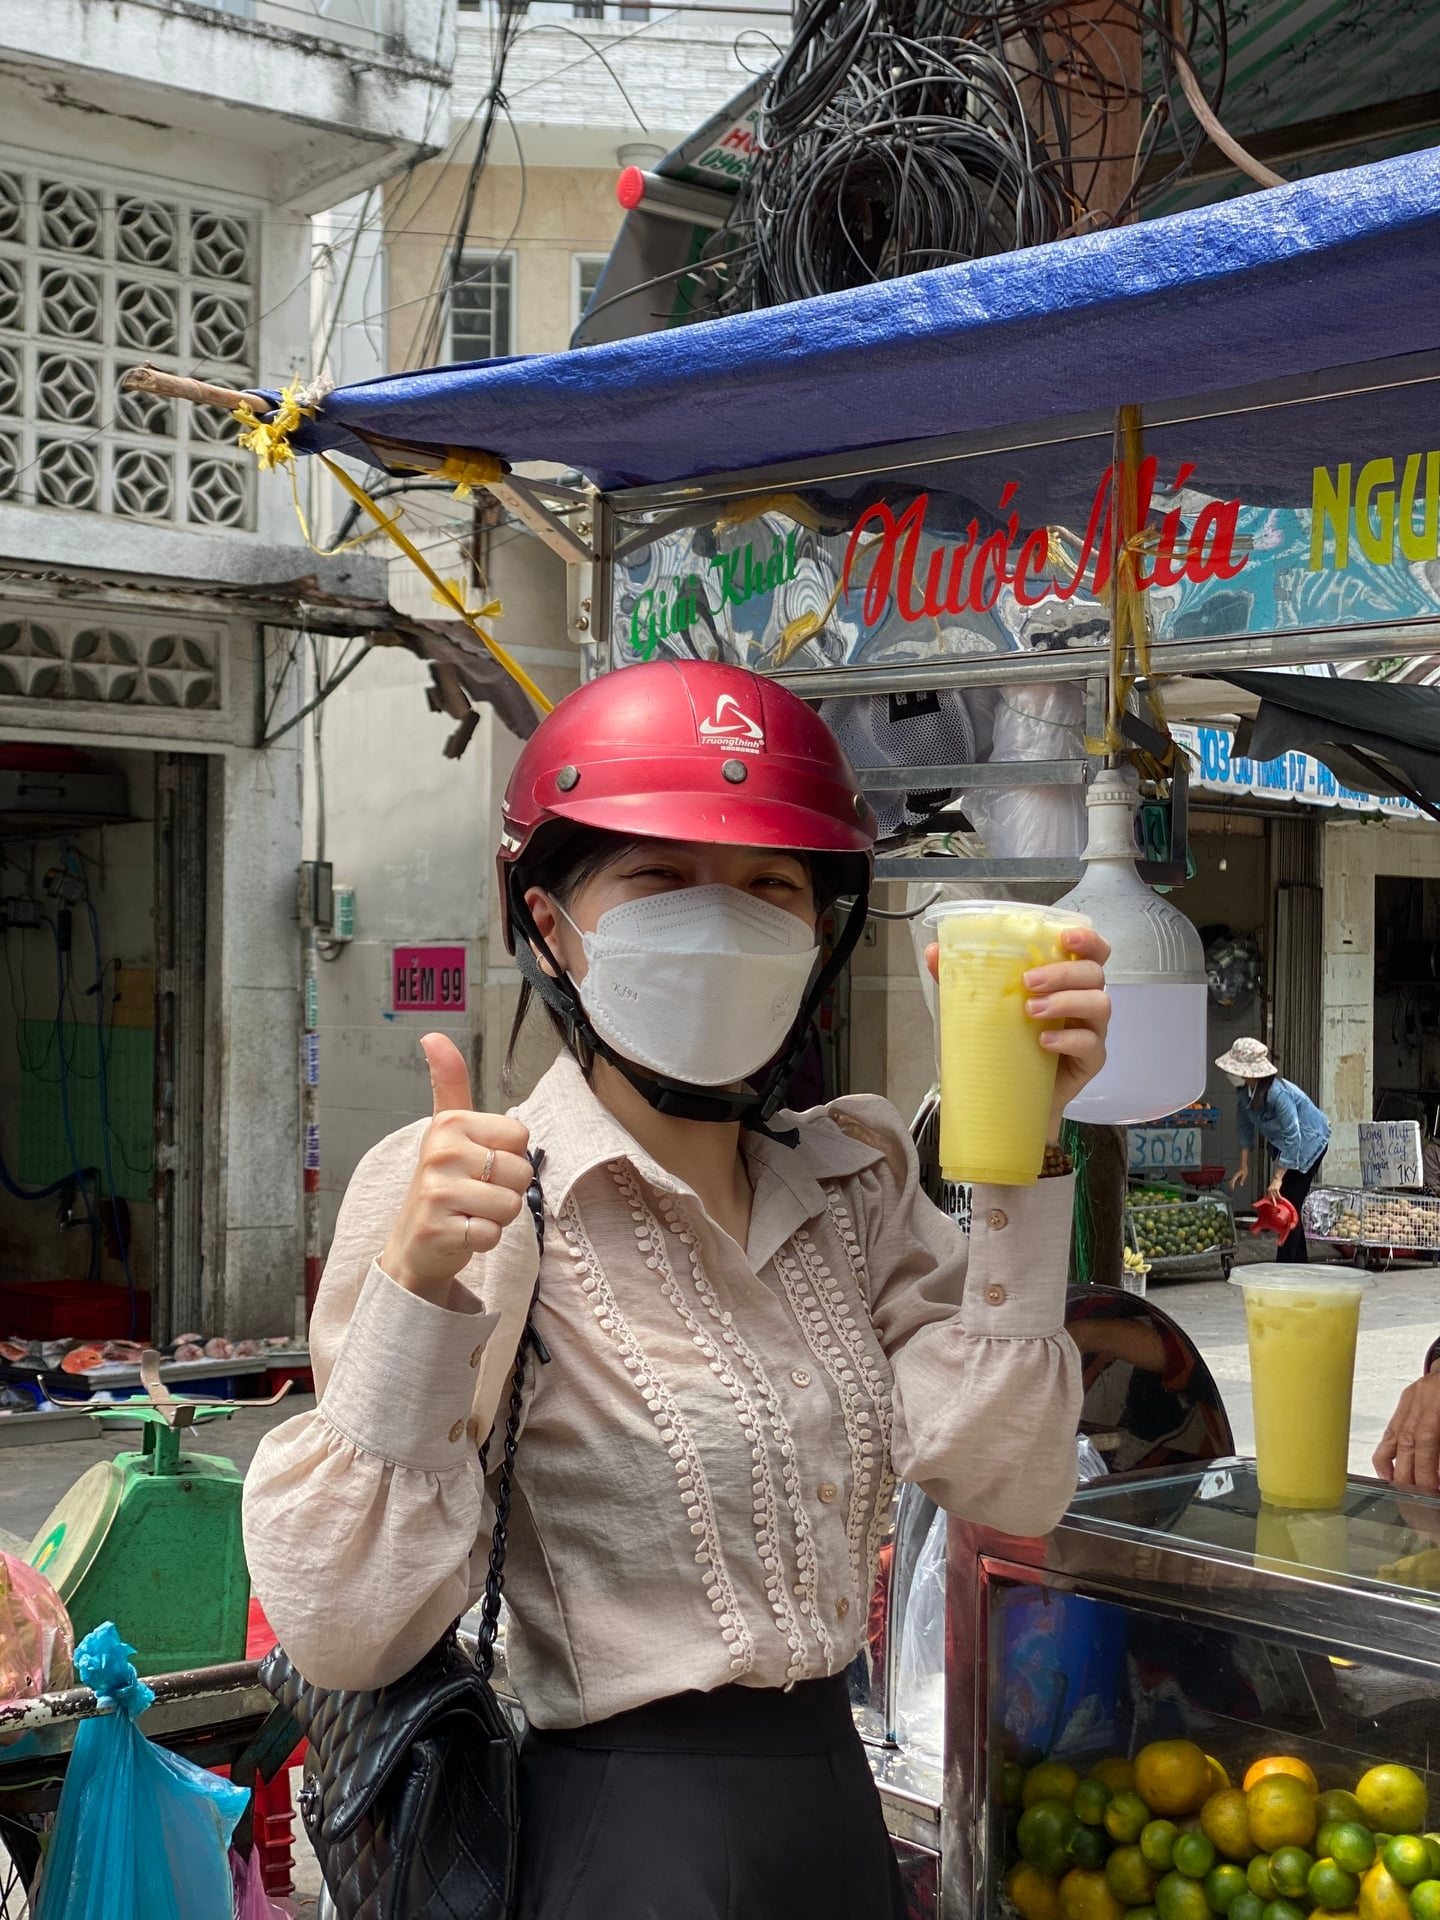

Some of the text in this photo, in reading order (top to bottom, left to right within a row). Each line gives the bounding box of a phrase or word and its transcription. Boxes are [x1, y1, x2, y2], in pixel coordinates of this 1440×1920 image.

[843, 456, 1249, 626] Nước Mía
[1310, 451, 1440, 573] NGU
[630, 530, 800, 661] Giải Khát
[1197, 726, 1230, 783] 103
[441, 967, 461, 1002] 99
